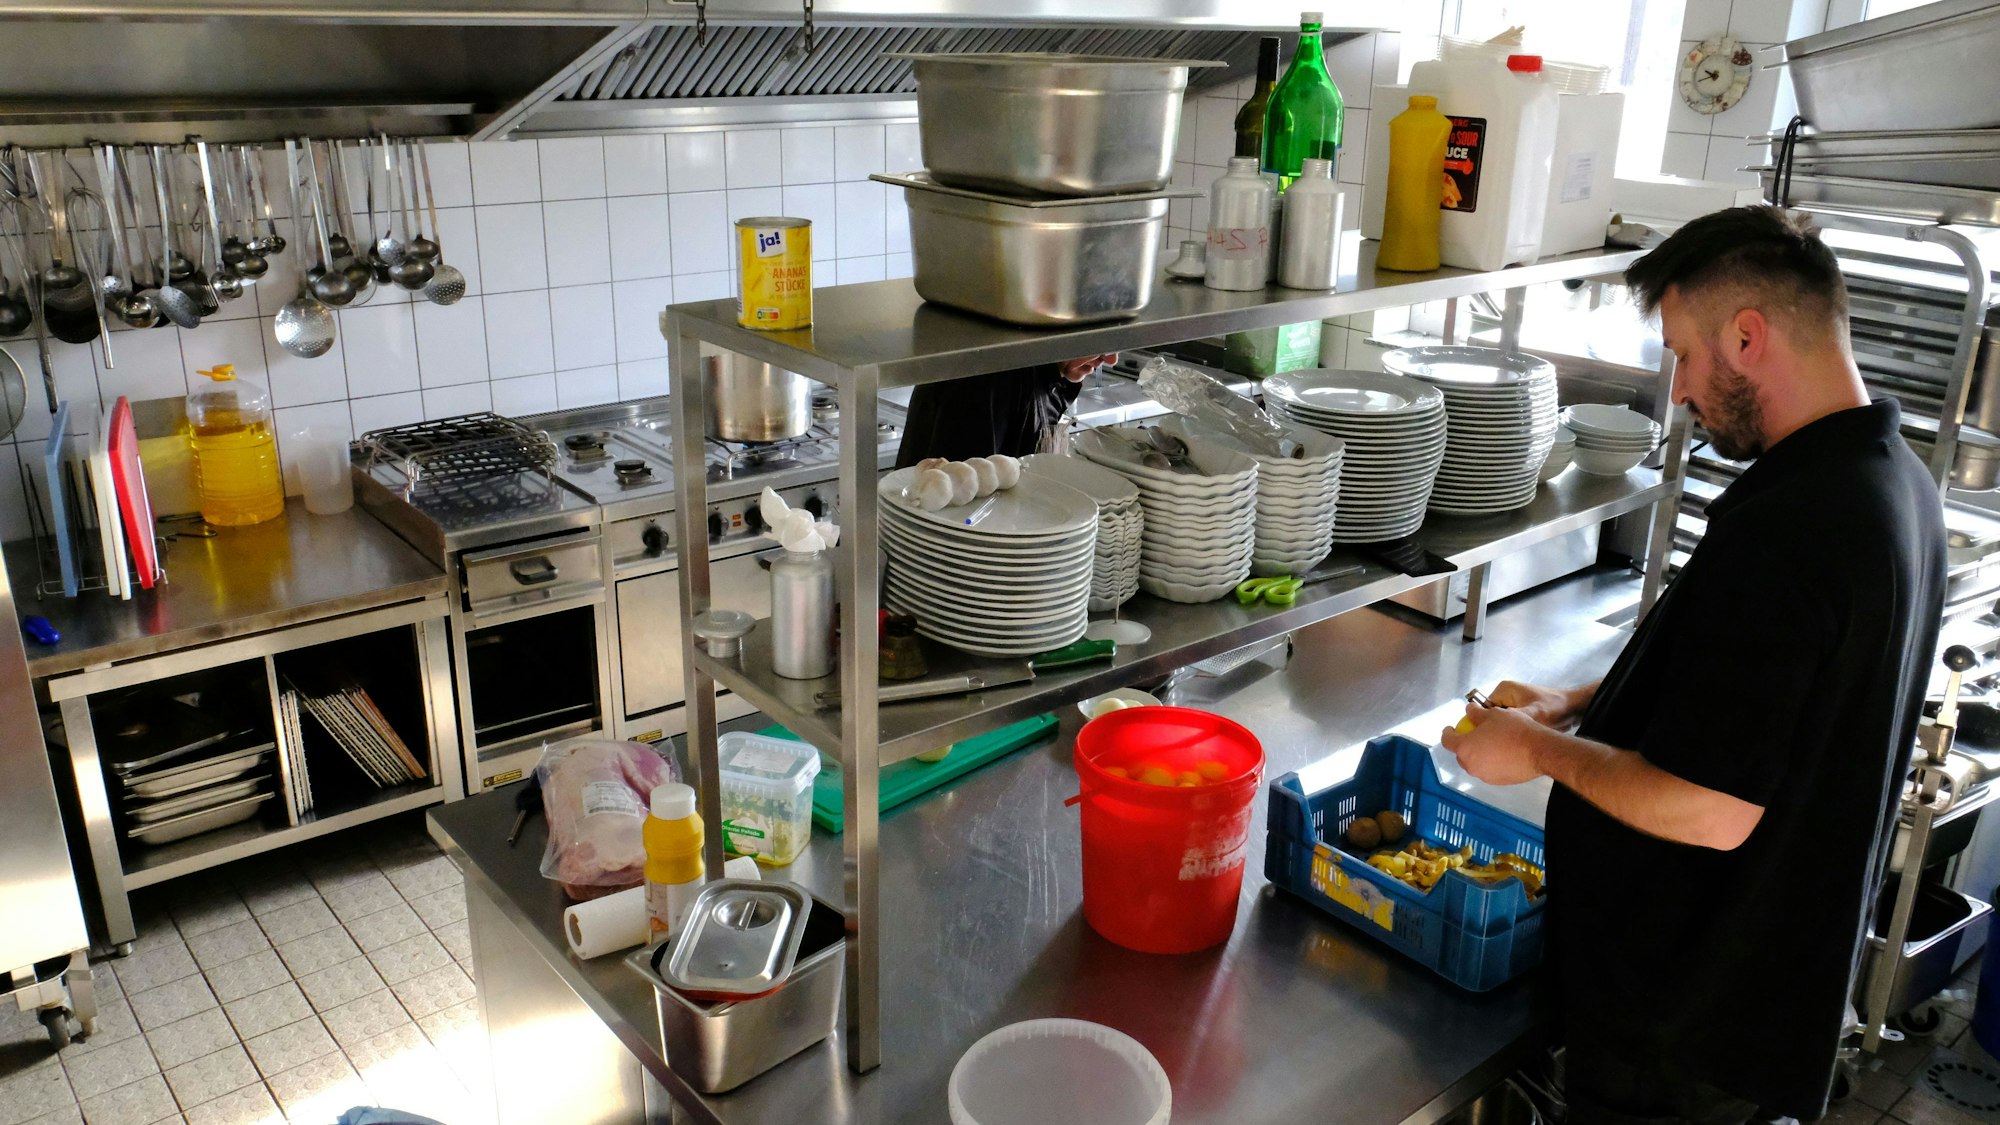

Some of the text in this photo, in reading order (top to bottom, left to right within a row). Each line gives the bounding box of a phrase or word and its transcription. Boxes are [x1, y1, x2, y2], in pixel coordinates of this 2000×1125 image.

[1456, 131, 1478, 147] SOUR
[1446, 147, 1468, 159] UCE
[759, 232, 780, 253] ja!
[772, 266, 807, 279] ANANAS
[775, 279, 806, 292] STÜCKE
